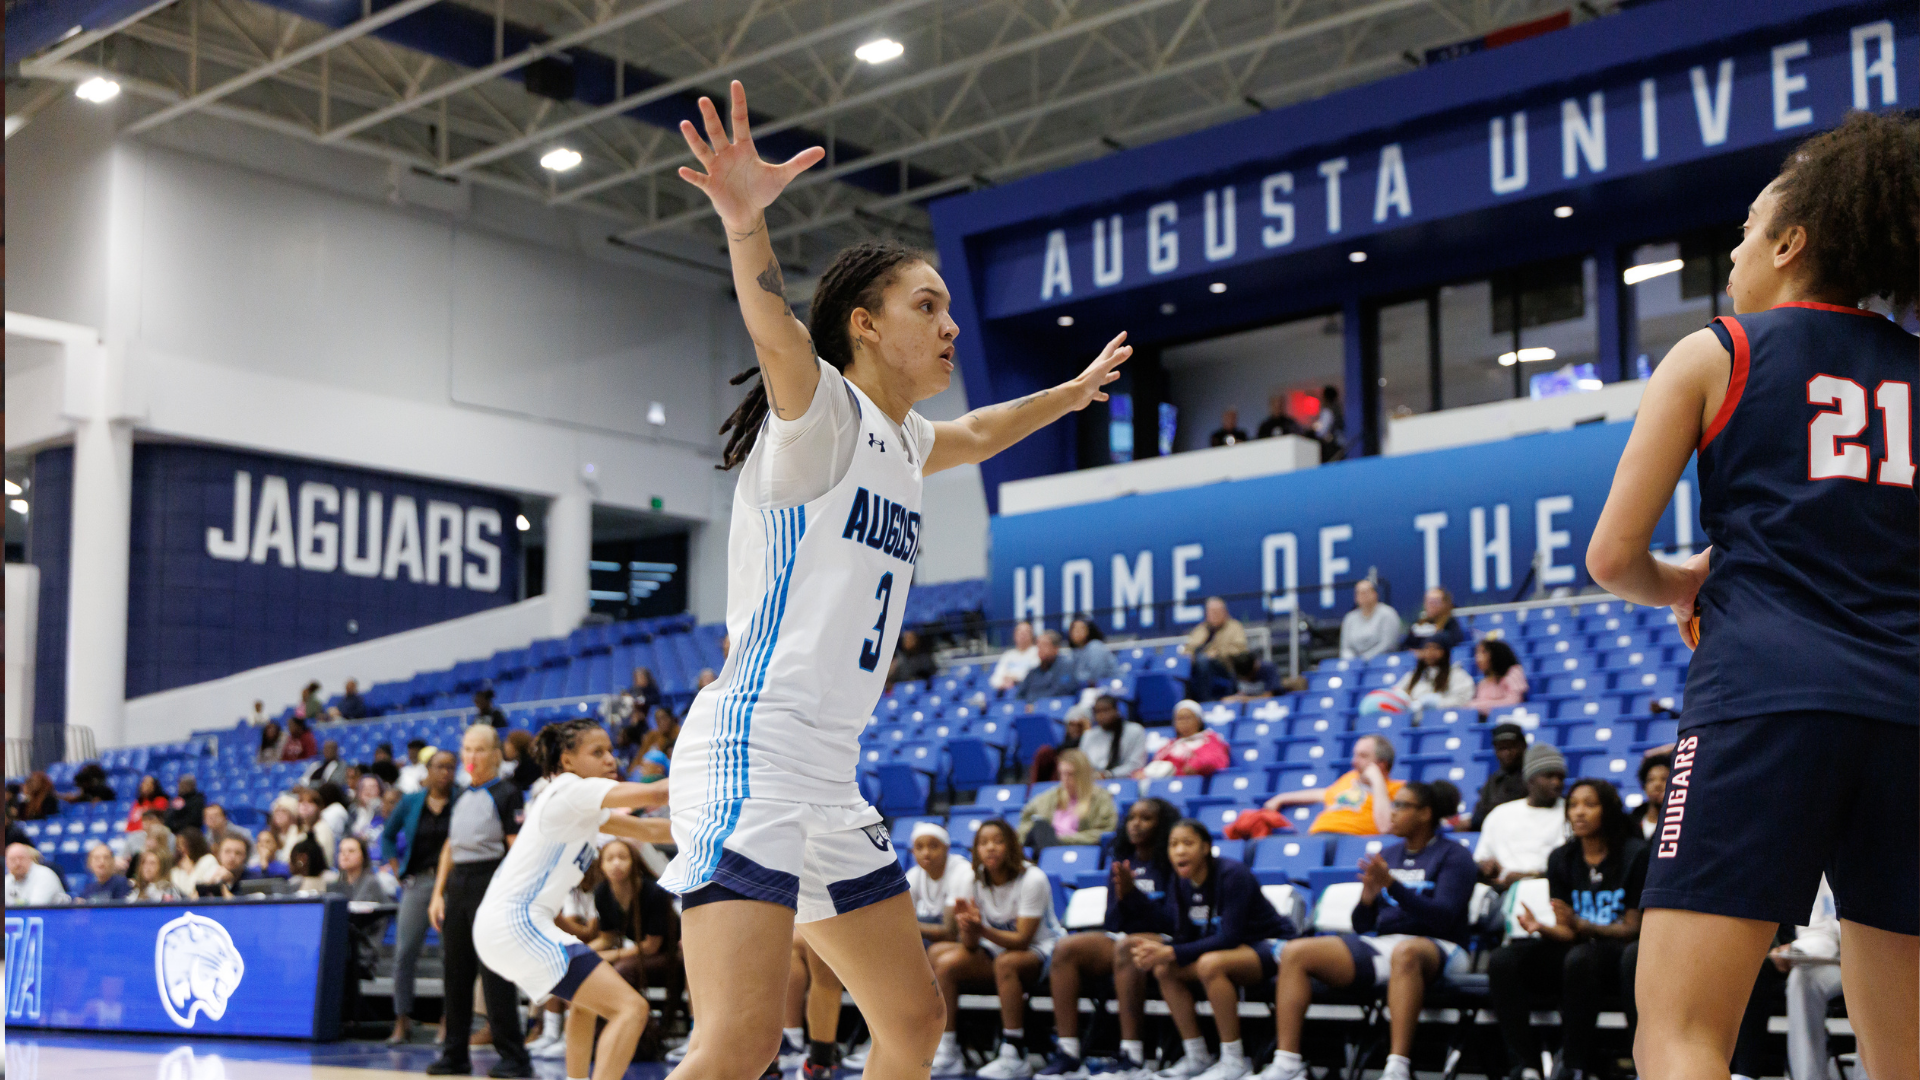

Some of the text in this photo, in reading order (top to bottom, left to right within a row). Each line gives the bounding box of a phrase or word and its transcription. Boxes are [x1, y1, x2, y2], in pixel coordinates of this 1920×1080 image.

[1040, 19, 1899, 300] AUGUSTA UNIVER
[1806, 372, 1918, 489] 21
[206, 469, 502, 594] JAGUARS
[842, 486, 921, 565] AUGUST
[1013, 543, 1204, 636] HOME
[1261, 523, 1353, 614] OF
[1413, 494, 1576, 594] THE
[859, 570, 894, 673] 3
[1657, 735, 1698, 858] COUGARS
